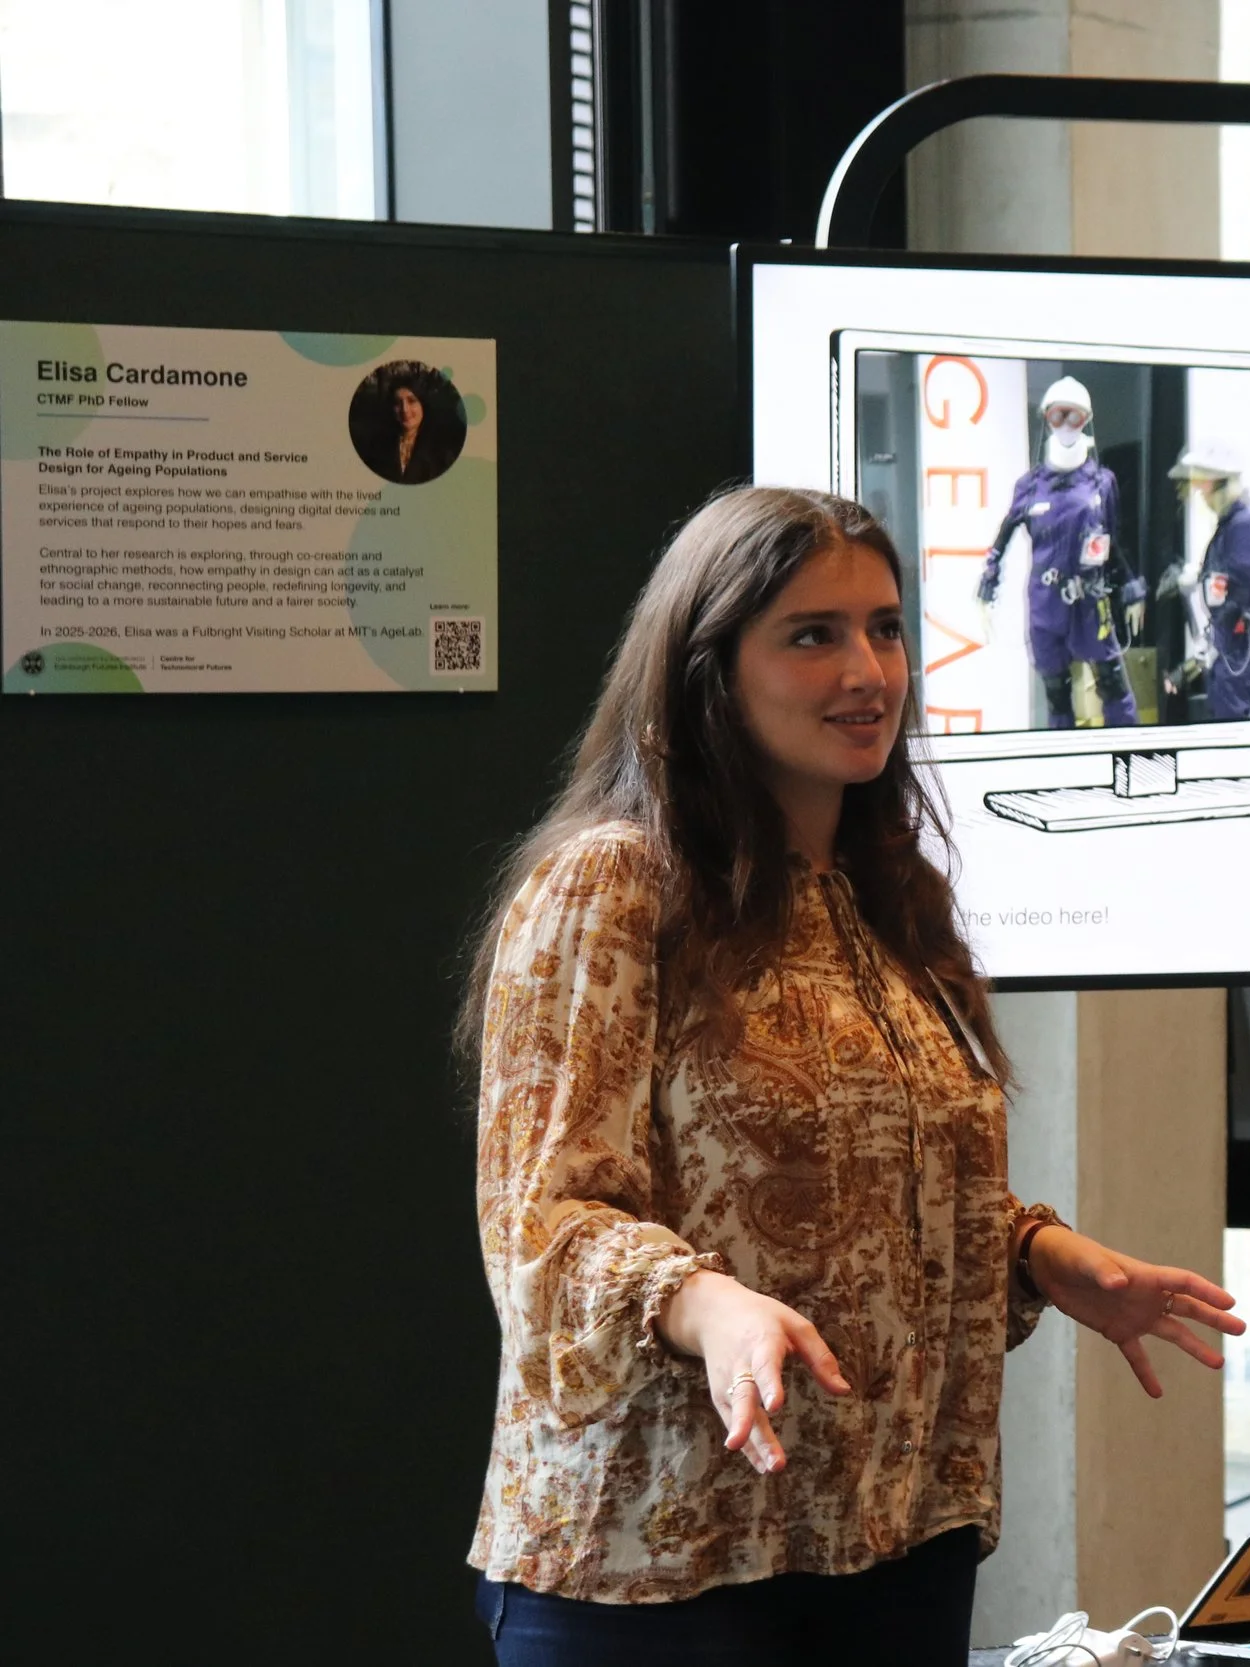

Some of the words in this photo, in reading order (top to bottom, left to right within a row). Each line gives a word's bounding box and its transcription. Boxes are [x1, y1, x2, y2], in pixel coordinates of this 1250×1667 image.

[37, 360, 97, 382] Elisa
[106, 362, 247, 387] Cardamone
[37, 393, 74, 404] CTMF
[78, 394, 104, 406] PhD
[108, 395, 148, 407] Fellow
[37, 445, 61, 457] The
[65, 446, 94, 458] Role
[98, 448, 110, 458] of
[114, 447, 168, 463] Empathy
[172, 449, 183, 459] in
[186, 449, 234, 461] Product
[238, 451, 260, 461] and
[264, 451, 308, 462] Service
[38, 461, 82, 476] Design
[86, 461, 104, 473] for
[107, 461, 151, 477] Ageing
[155, 461, 227, 477] Populations
[38, 485, 77, 496] Elisa's
[80, 486, 121, 499] project
[124, 486, 174, 499] explores
[177, 486, 202, 498] how
[205, 489, 221, 498] we
[224, 489, 245, 498] can
[249, 488, 307, 500] empathise
[310, 489, 332, 499] with
[336, 489, 353, 500] the
[356, 489, 381, 501] lived
[38, 500, 104, 515] experience
[107, 500, 119, 513] of
[122, 503, 162, 515] ageing
[166, 502, 236, 517] populations,
[239, 503, 295, 519] designing
[298, 504, 331, 519] digital
[334, 504, 376, 516] devices
[379, 505, 400, 516] and
[39, 516, 88, 527] services
[91, 516, 113, 527] that
[116, 516, 165, 530] respond
[168, 518, 180, 528] to
[183, 517, 208, 528] their
[211, 518, 247, 531] hopes
[250, 518, 272, 529] and
[39, 546, 82, 559] Central
[85, 548, 97, 558] to
[100, 548, 119, 559] her
[123, 548, 174, 559] research
[177, 548, 186, 560] is
[190, 549, 246, 562] exploring,
[249, 549, 293, 563] through
[296, 550, 358, 562] co-creation
[361, 551, 382, 561] and
[39, 563, 118, 579] ethnographic
[121, 564, 175, 576] methods,
[179, 564, 204, 575] how
[207, 565, 256, 578] empathy
[260, 565, 270, 576] in
[273, 564, 310, 578] design
[313, 567, 334, 576] can
[337, 566, 354, 576] act
[357, 568, 370, 576] as
[372, 567, 379, 576] a
[382, 566, 423, 578] catalyst
[40, 578, 55, 590] for
[58, 579, 93, 590] social
[97, 579, 144, 592] change,
[148, 580, 223, 593] reconnecting
[226, 579, 268, 592] people,
[272, 580, 327, 593] redefining
[330, 580, 381, 594] longevity,
[384, 580, 405, 591] and
[40, 594, 84, 608] leading
[87, 595, 99, 605] to
[102, 597, 109, 606] a
[113, 597, 143, 606] more
[146, 595, 212, 606] sustainable
[215, 595, 248, 606] future
[251, 596, 273, 606] and
[276, 598, 283, 606] a
[286, 596, 313, 606] fairer
[40, 625, 52, 636] In
[54, 626, 120, 637] 2025-2026,
[124, 625, 152, 637] Elisa
[155, 628, 178, 637] was
[181, 628, 188, 637] a
[192, 626, 242, 639] Fulbright
[245, 626, 286, 639] Visiting
[289, 626, 331, 637] Scholar
[334, 627, 345, 636] at
[348, 626, 377, 637] MIT's
[998, 907, 1053, 926] video
[1059, 906, 1109, 925] here!
